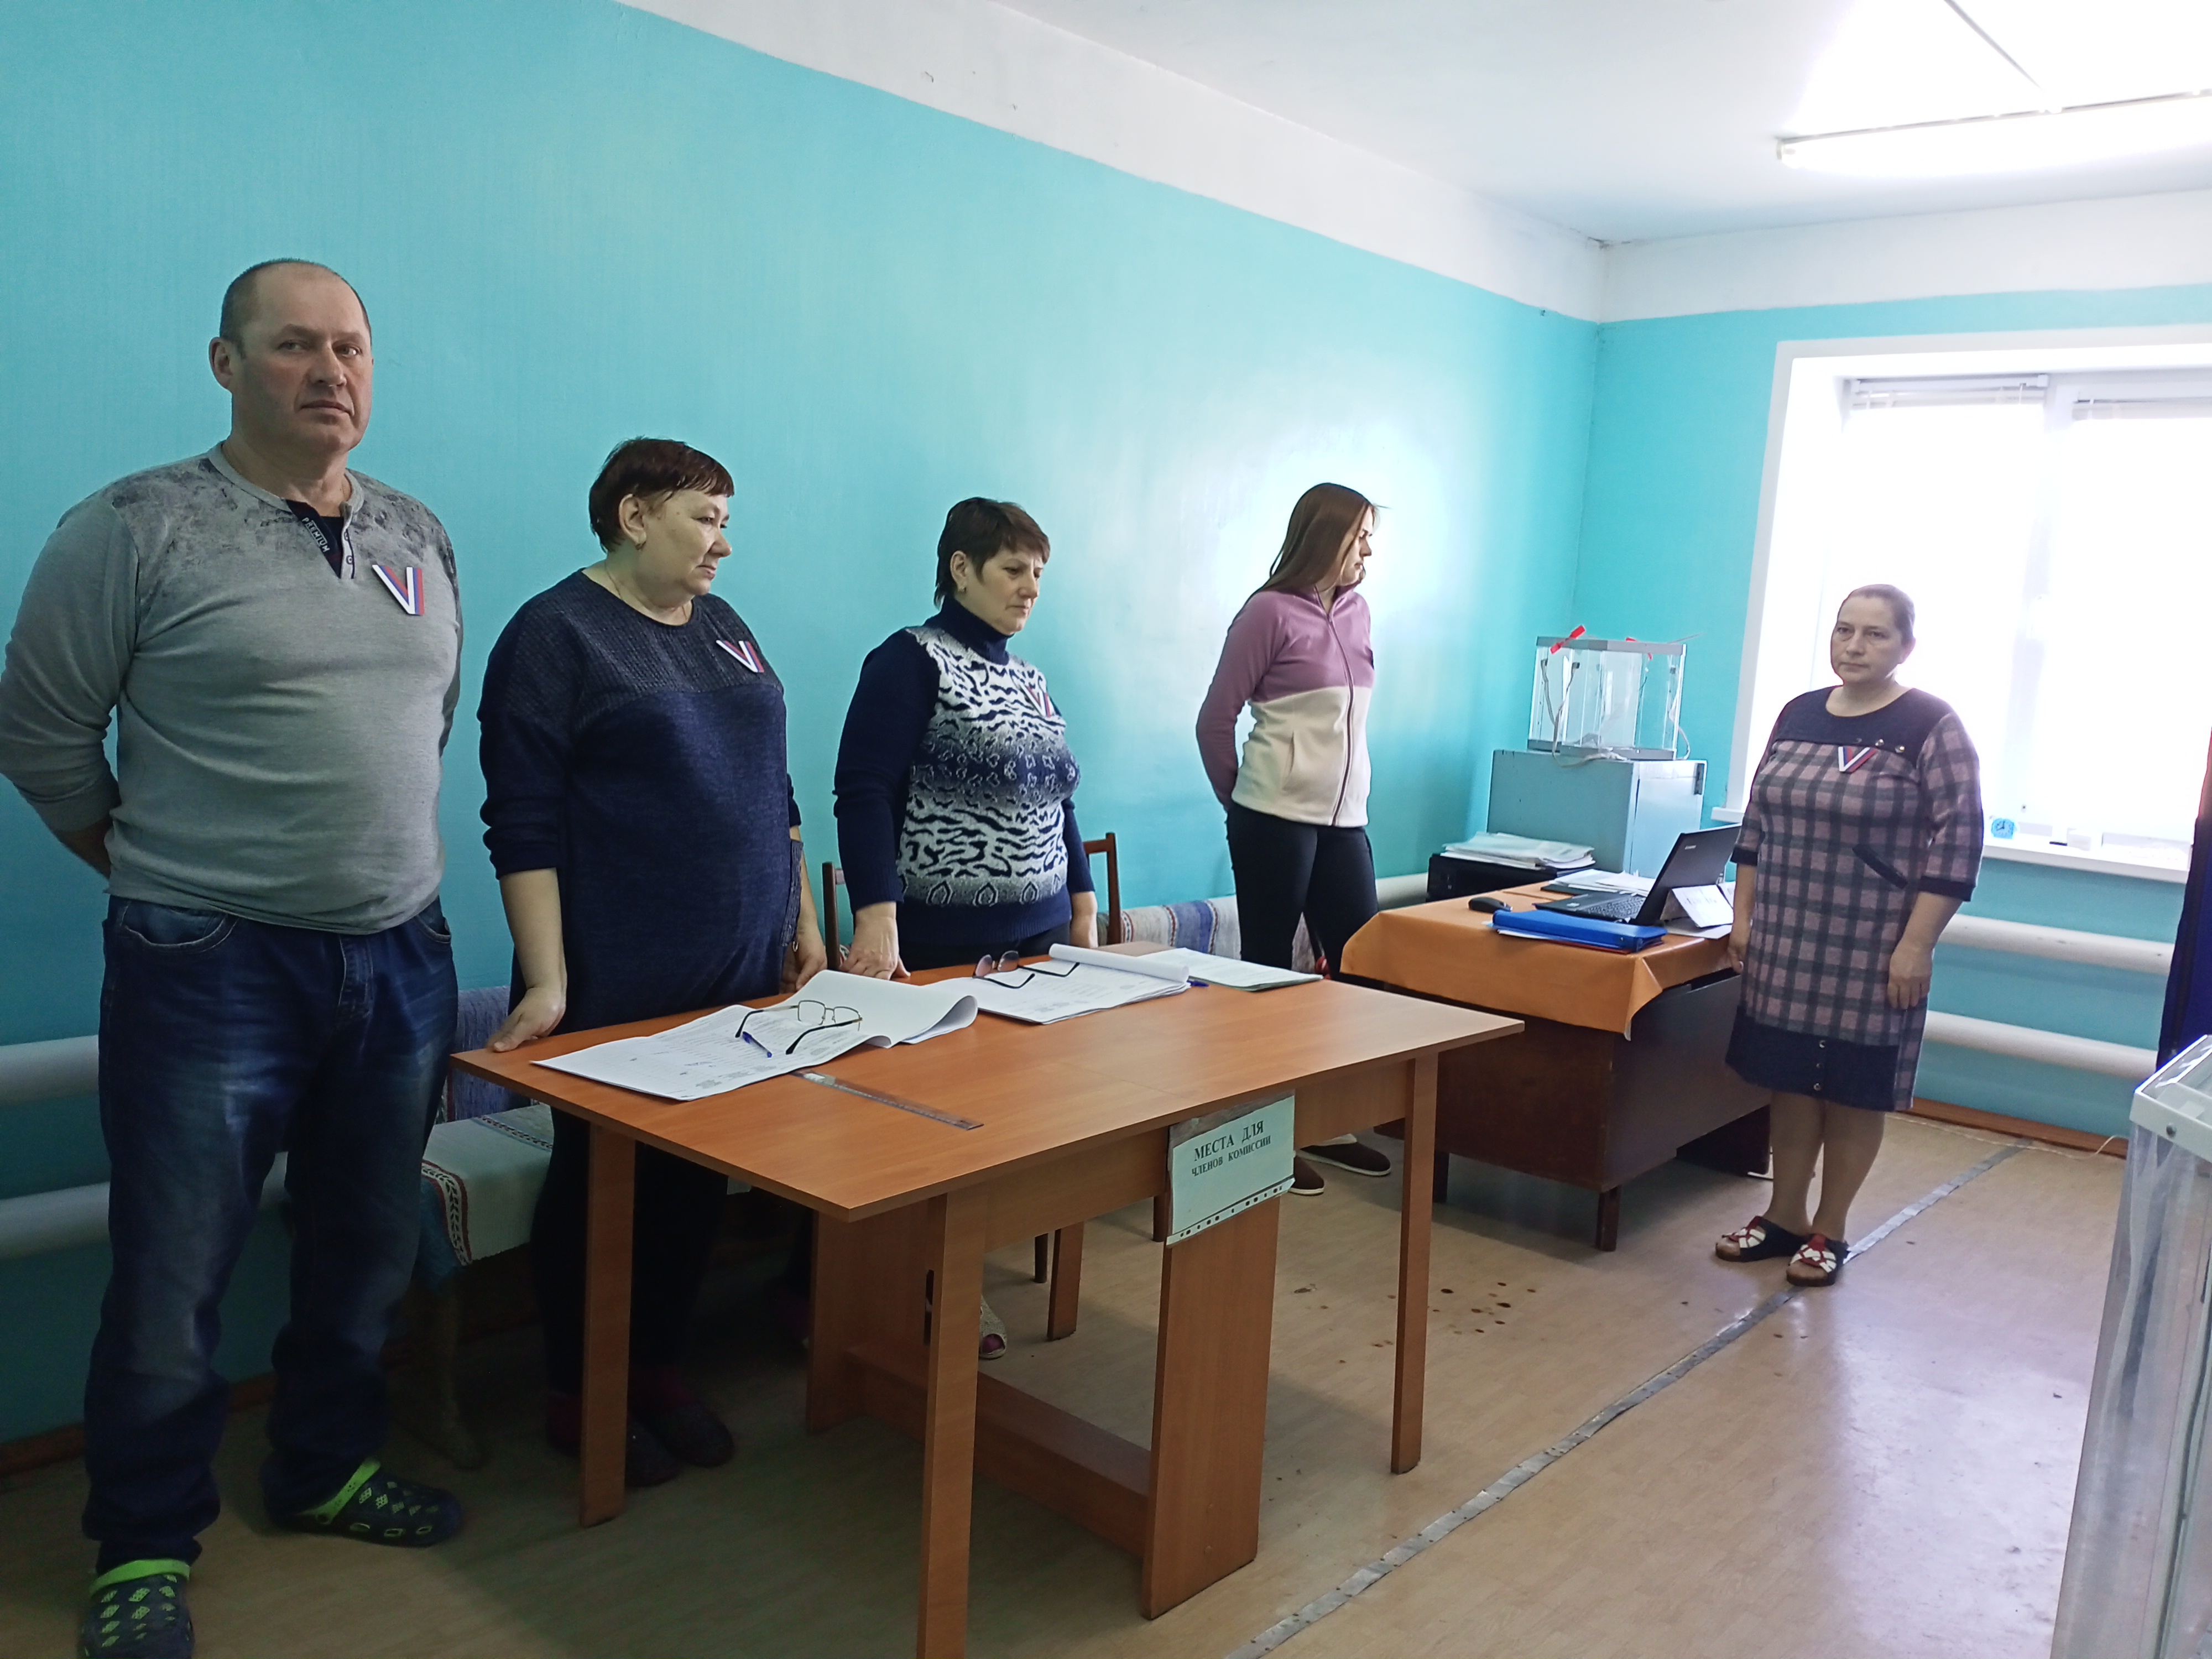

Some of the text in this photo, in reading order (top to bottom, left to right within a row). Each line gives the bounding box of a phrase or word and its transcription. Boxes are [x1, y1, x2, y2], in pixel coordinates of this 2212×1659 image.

[301, 517, 330, 552] PREMIUM
[372, 564, 425, 615] V
[716, 640, 764, 673] V
[1838, 747, 1877, 773] V
[1192, 1135, 1271, 1176] ЧЛЕНОВ КОМИССИИ
[1194, 1120, 1264, 1161] МЕСТА ДЛЯ
